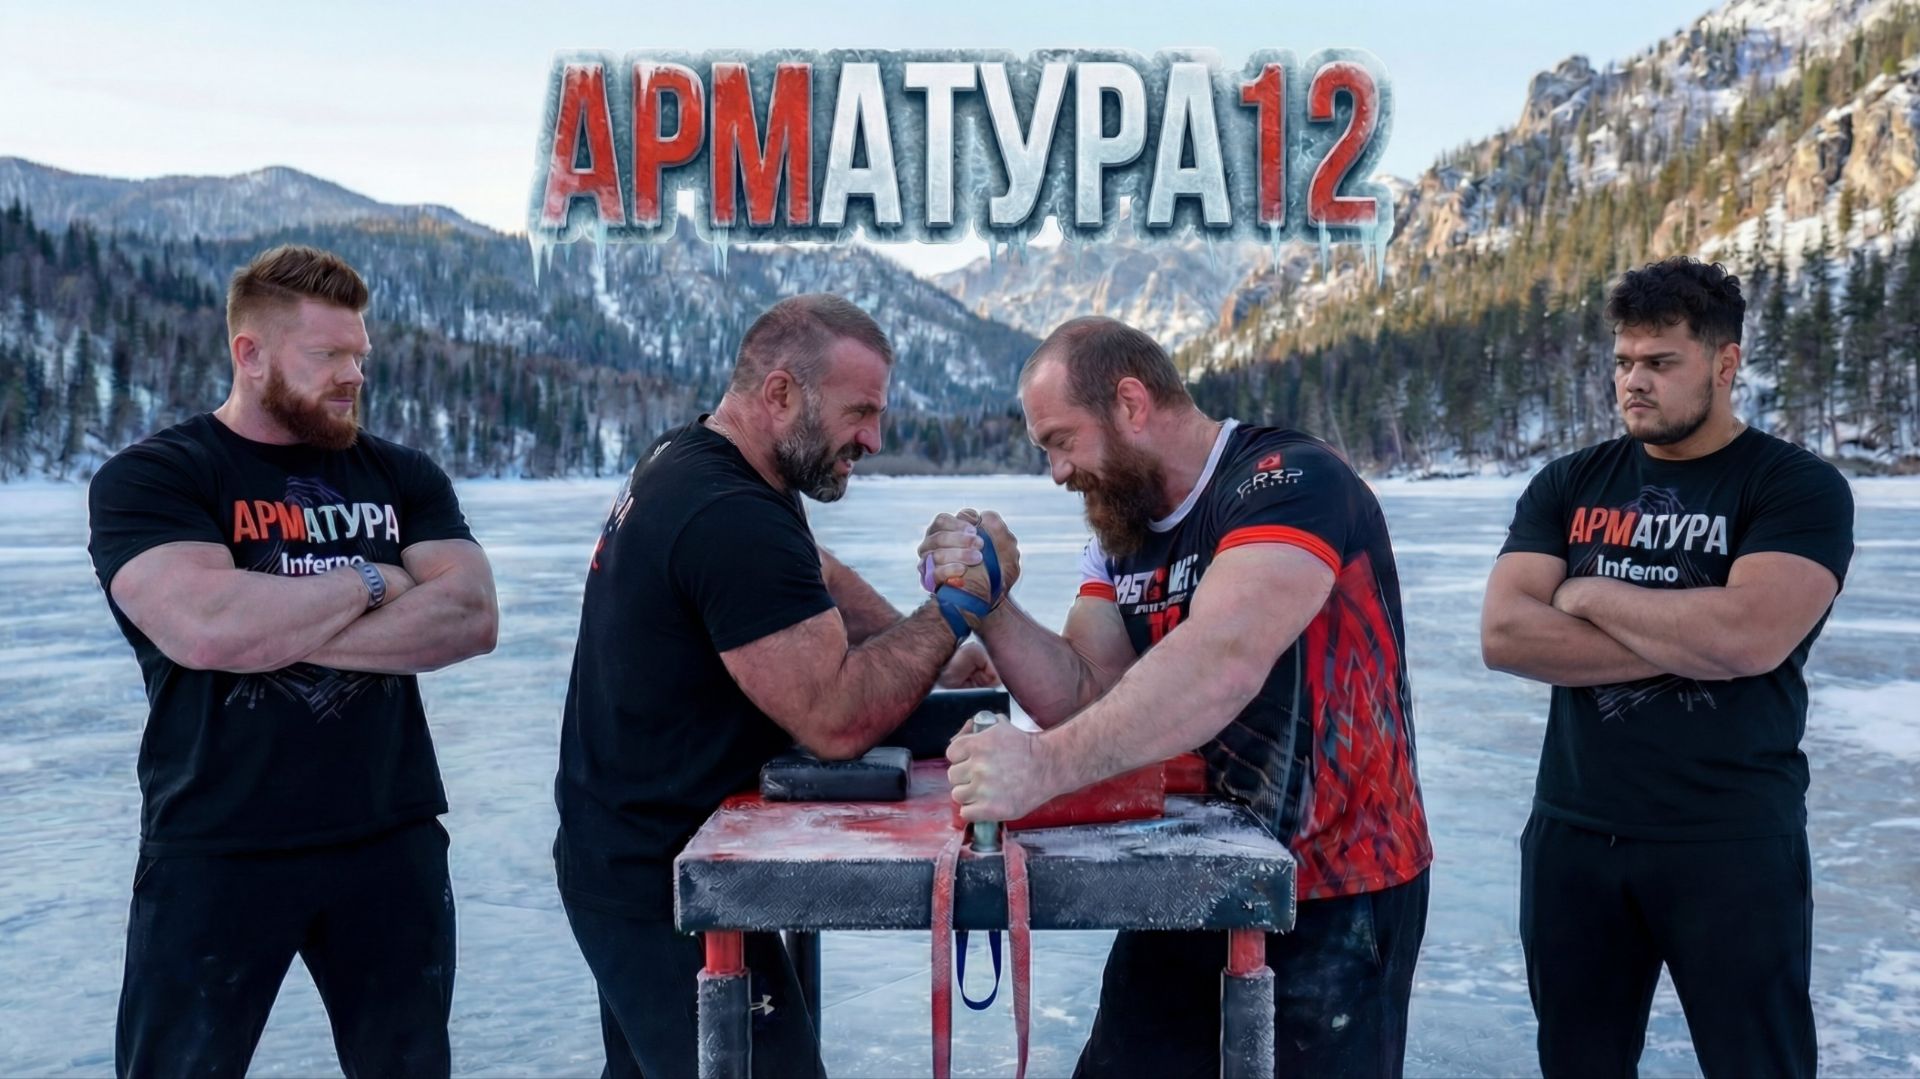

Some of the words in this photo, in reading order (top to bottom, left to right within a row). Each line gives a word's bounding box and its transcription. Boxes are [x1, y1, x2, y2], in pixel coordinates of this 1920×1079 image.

[233, 500, 400, 544] АРМАТУРА
[1568, 507, 1728, 556] АРМАТУРА
[1597, 554, 1679, 582] Inferno
